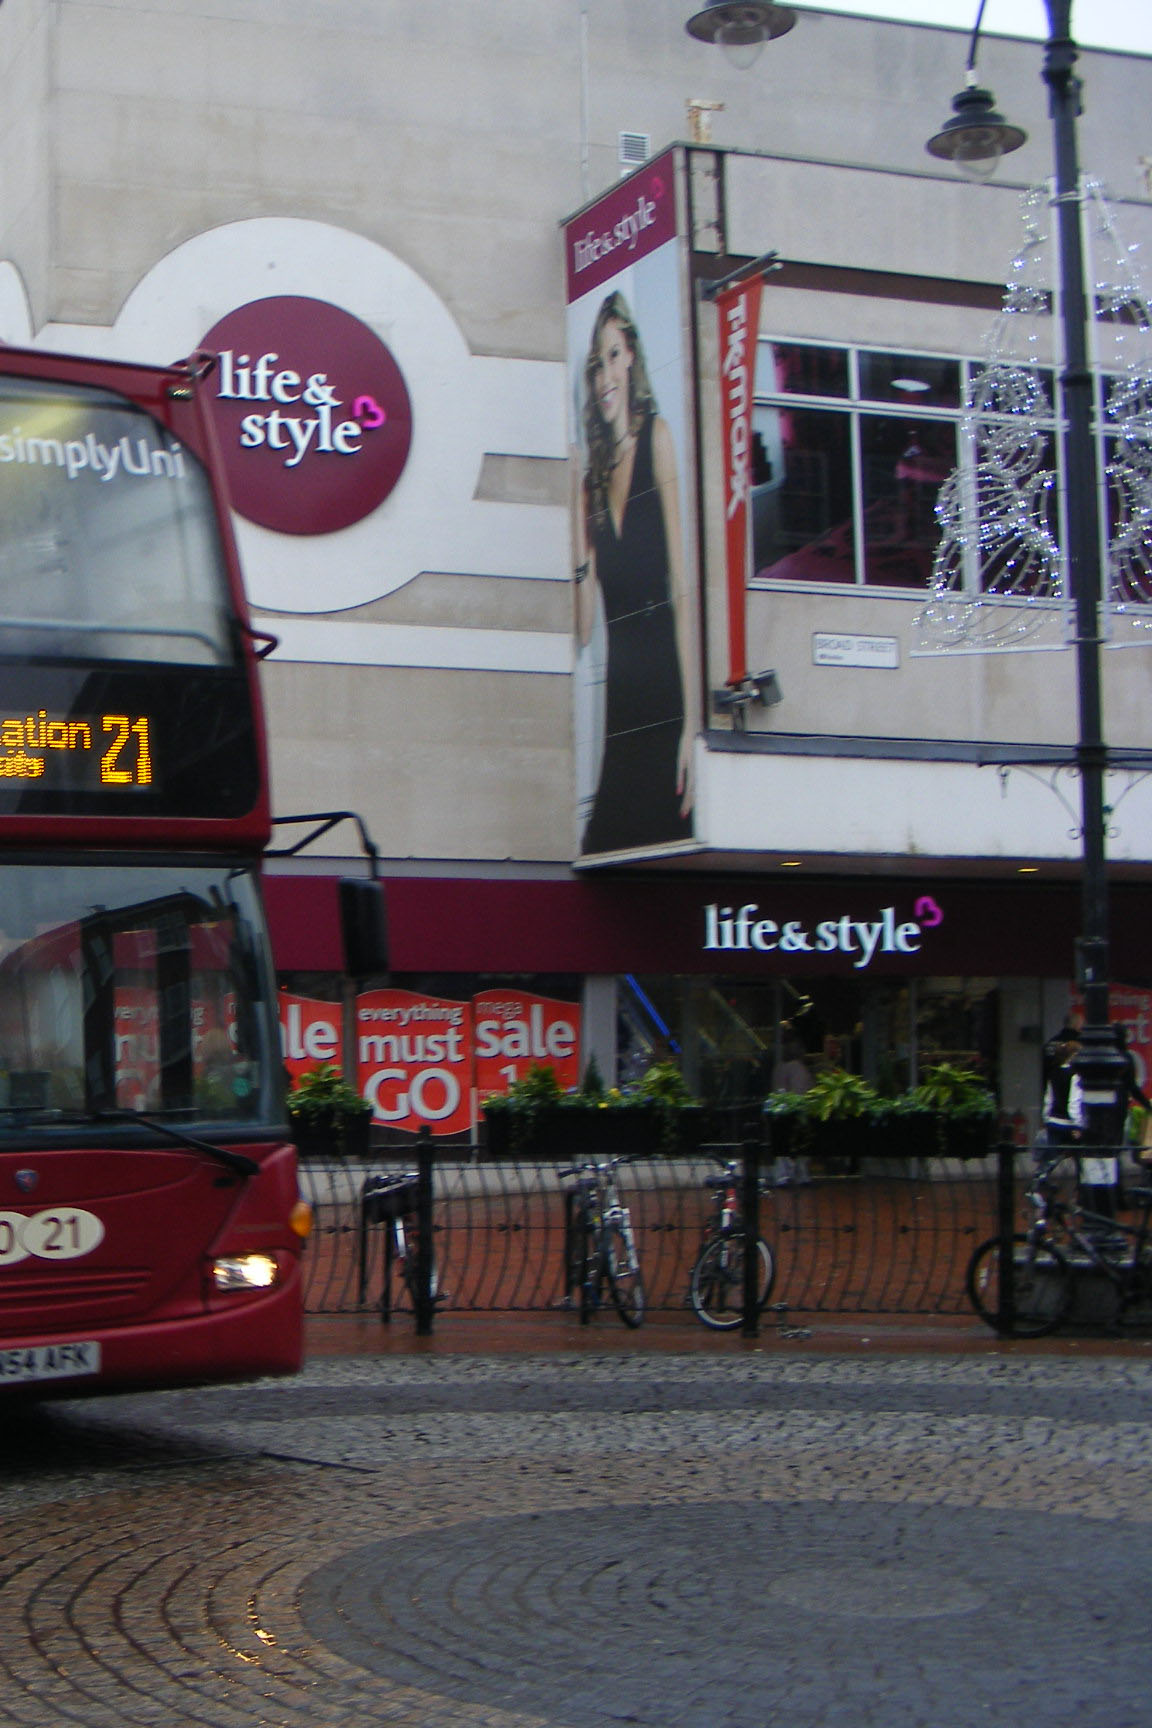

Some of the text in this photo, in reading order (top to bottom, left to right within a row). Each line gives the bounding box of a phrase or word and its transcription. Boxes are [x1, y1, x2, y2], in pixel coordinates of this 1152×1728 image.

[240, 404, 363, 467] style
[100, 714, 152, 784] 21
[358, 1002, 464, 1027] everything
[475, 1003, 577, 1058] sale
[359, 1027, 466, 1064] must
[363, 1067, 461, 1121] GO
[42, 1214, 80, 1251] 21
